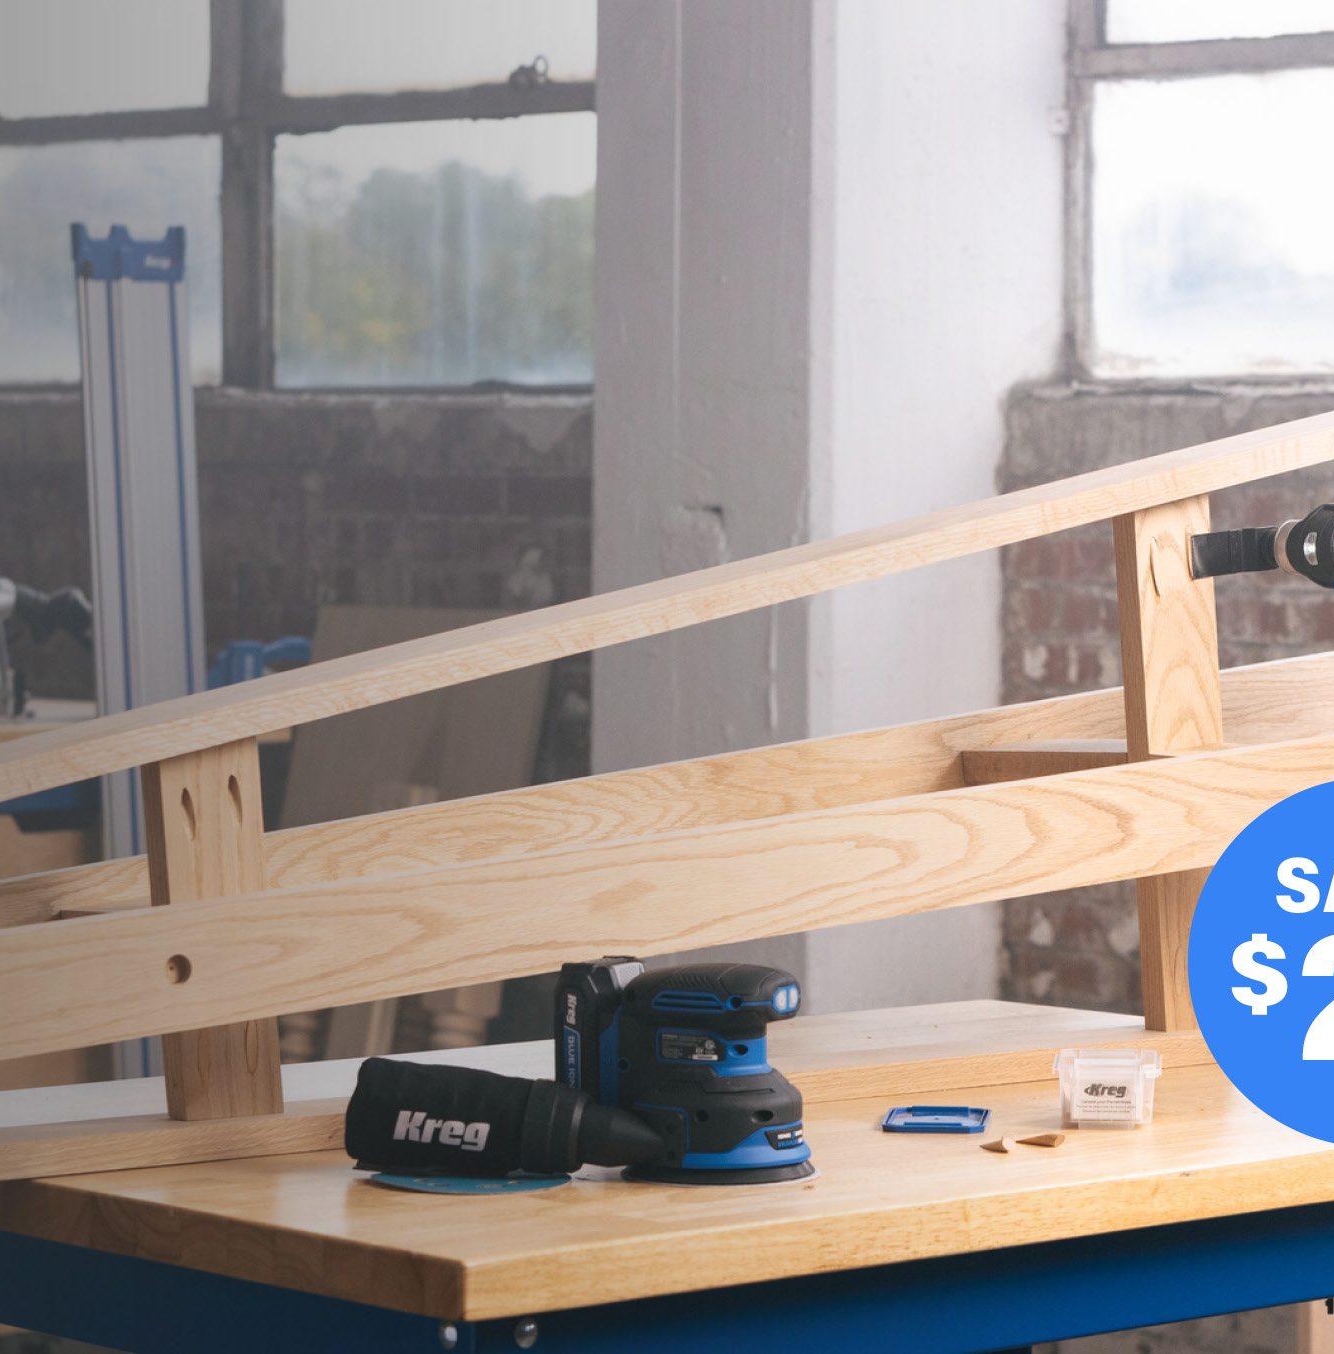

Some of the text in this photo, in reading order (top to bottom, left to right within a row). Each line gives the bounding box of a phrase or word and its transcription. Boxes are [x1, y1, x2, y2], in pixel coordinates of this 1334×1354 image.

[566, 993, 577, 1025] Kreg
[568, 1035, 576, 1065] BLUE
[1084, 1083, 1127, 1098] Kreg
[393, 1110, 491, 1152] Kreg
